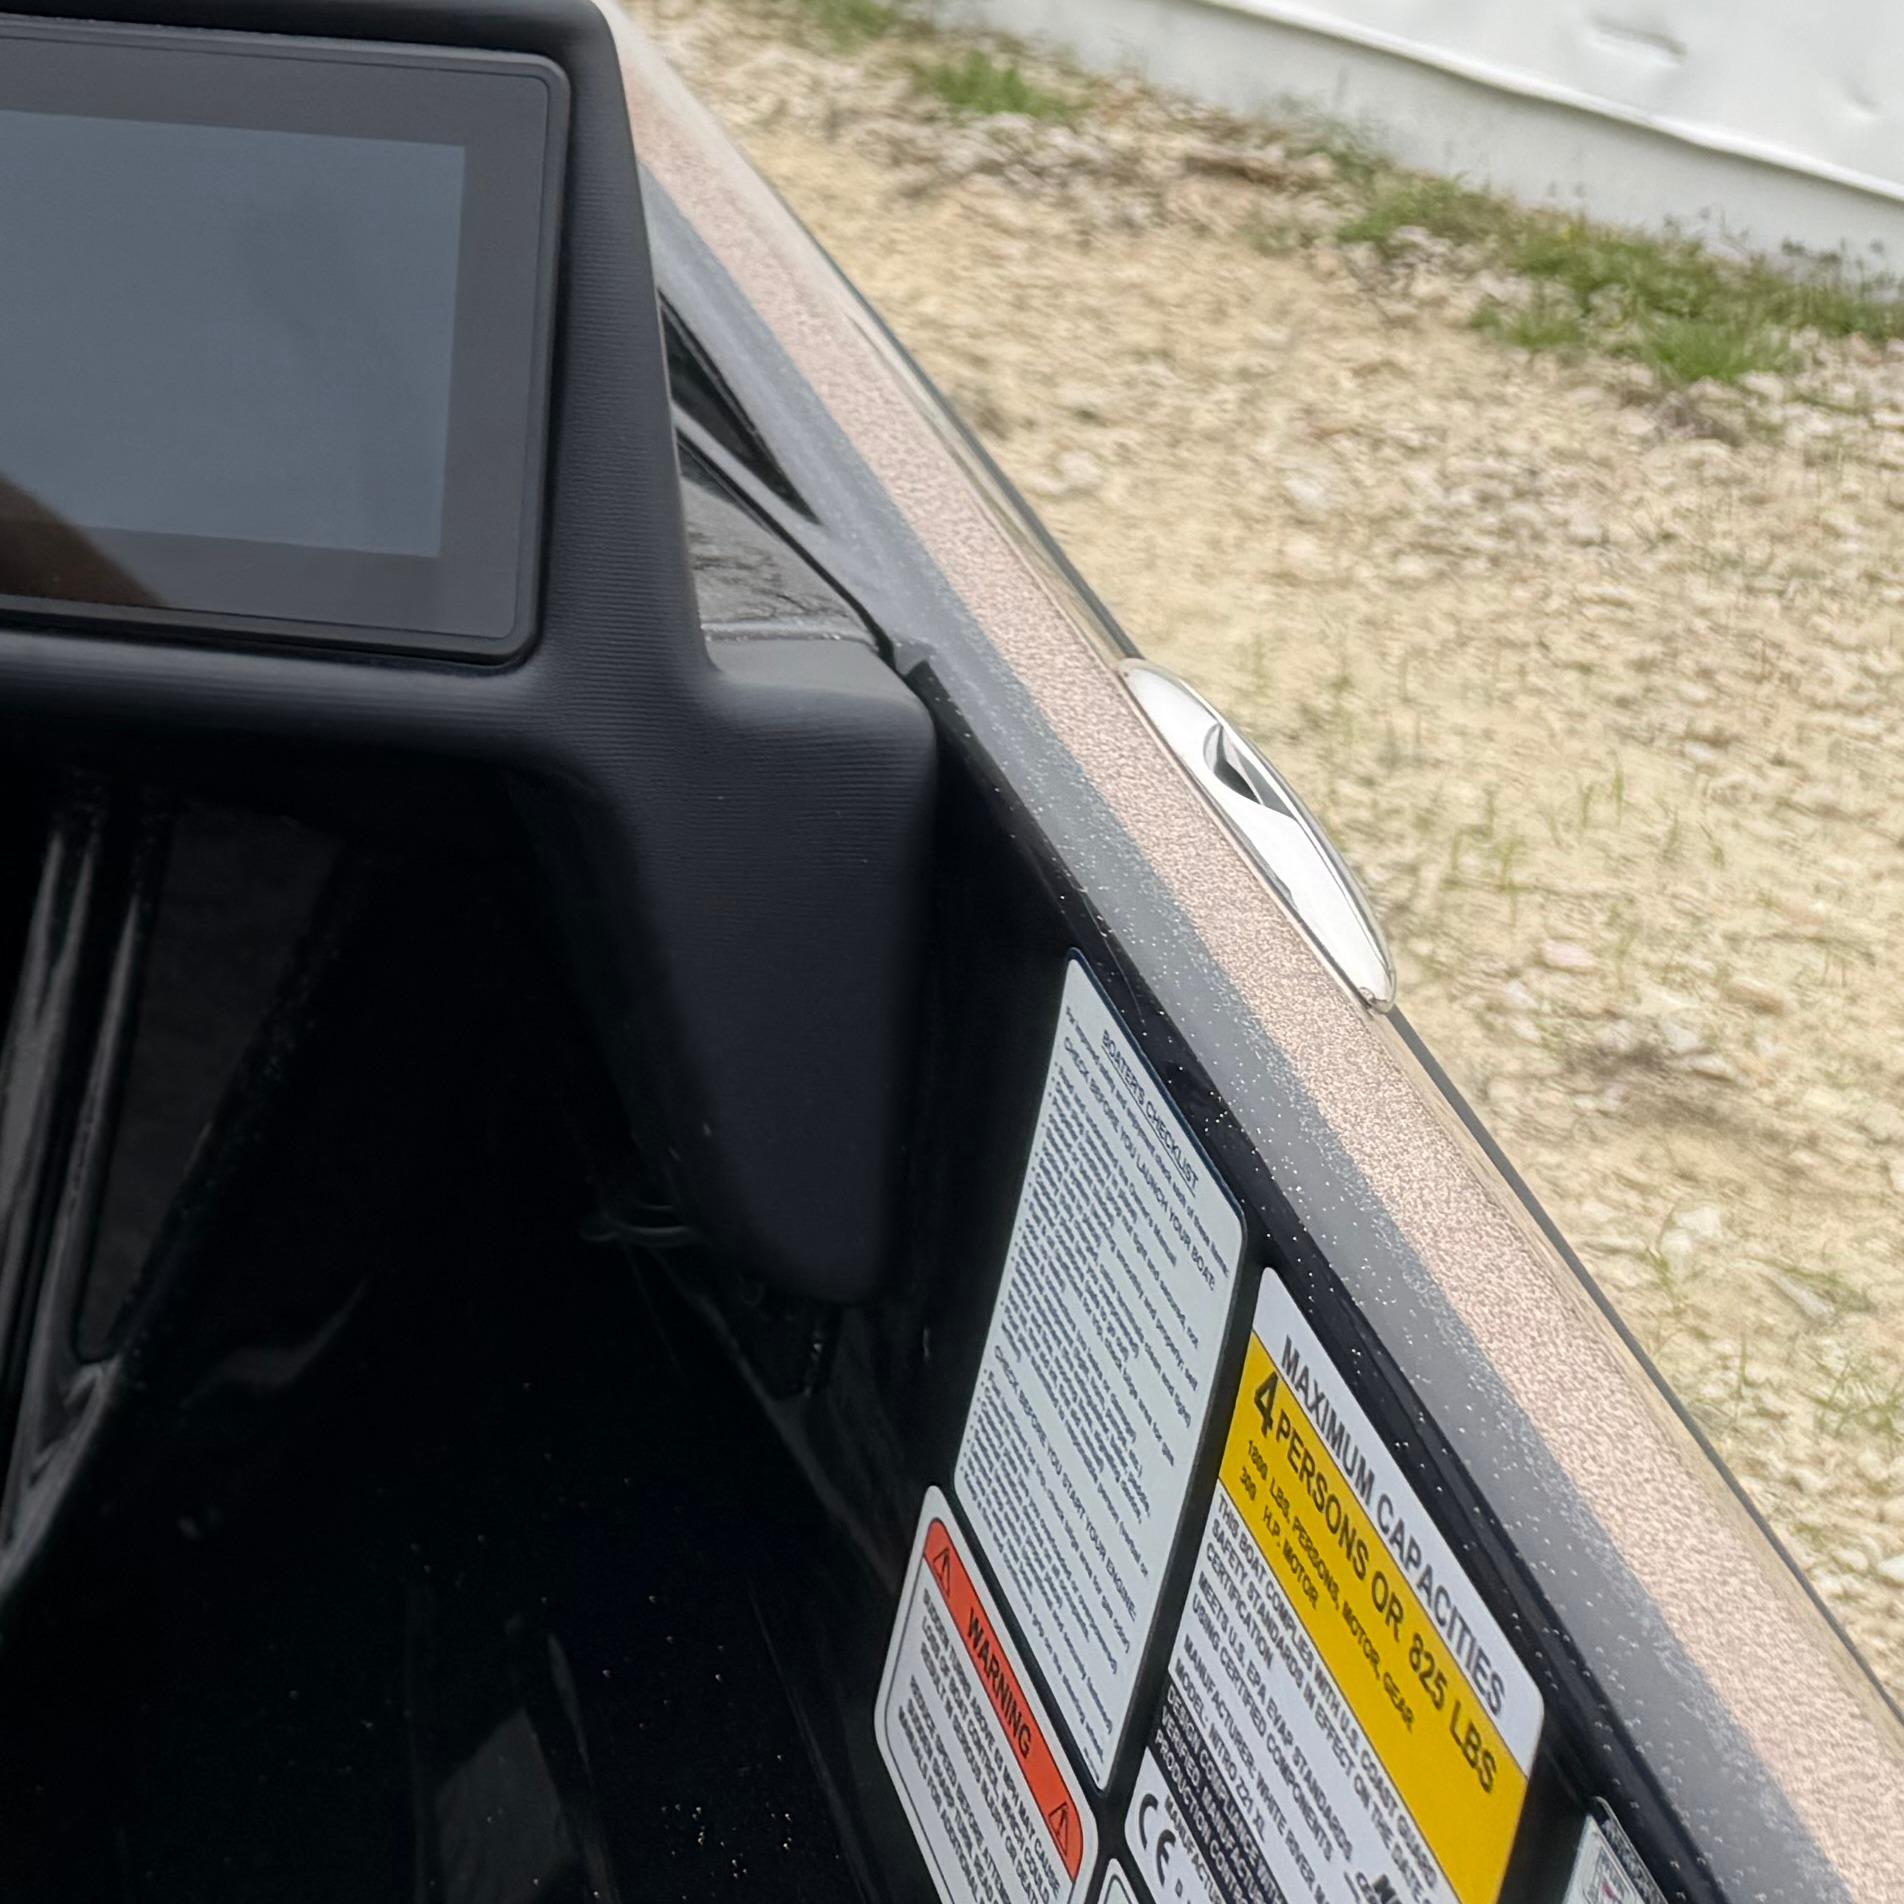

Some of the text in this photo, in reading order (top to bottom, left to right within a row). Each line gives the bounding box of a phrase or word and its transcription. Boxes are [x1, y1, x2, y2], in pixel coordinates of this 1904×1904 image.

[1119, 1126, 1136, 1161] YOU
[1167, 1206, 1191, 1253] YOUR
[1145, 1097, 1198, 1192] CHECKLIST
[1045, 1440, 1062, 1480] YOU
[1061, 1470, 1085, 1524] START
[1084, 1515, 1106, 1564] YOUR
[1280, 1333, 1507, 1720] MAXIMUM CAPACITIES
[1205, 1538, 1273, 1671] CERTIFICATION
[1250, 1354, 1498, 1799] 4 PERSONS OR 825 LBS
[1281, 1536, 1319, 1611] MOTOR
[965, 1606, 1033, 1762] WARNING
[1191, 1591, 1220, 1654] USING
[1219, 1642, 1267, 1741] CERTIFIED
[1265, 1728, 1333, 1864] COMPONENTS
[1197, 1569, 1229, 1635] MEETS
[1246, 1658, 1267, 1706] EPA
[1265, 1694, 1294, 1755] EVAP
[1291, 1742, 1353, 1865] STANDARDS
[1211, 1515, 1247, 1589] SAFETY
[1246, 1577, 1304, 1691] STANDARDS
[1302, 1679, 1315, 1712] IN
[1314, 1700, 1354, 1781] EFFECT
[1352, 1769, 1371, 1812] ON
[1369, 1799, 1394, 1853] THE
[1217, 1491, 1239, 1540] THIS
[1238, 1529, 1266, 1588] BOAT
[1264, 1576, 1315, 1675] COMPLIES
[1313, 1662, 1340, 1720] WITH
[1359, 1744, 1398, 1822] COAST
[1395, 1808, 1438, 1894] GUARD
[1381, 1667, 1415, 1734] GEAR
[1017, 1798, 1035, 1844] MAY
[1154, 1725, 1211, 1847] PRODUCTION
[1166, 1681, 1258, 1870] DESIGN COMPLIANCE
[1208, 1720, 1238, 1786] NITRO
[1235, 1772, 1253, 1816] Z21
[1252, 1805, 1268, 1844] XL
[1255, 1769, 1287, 1838] WHITE
[1284, 1825, 1316, 1893] RIVER
